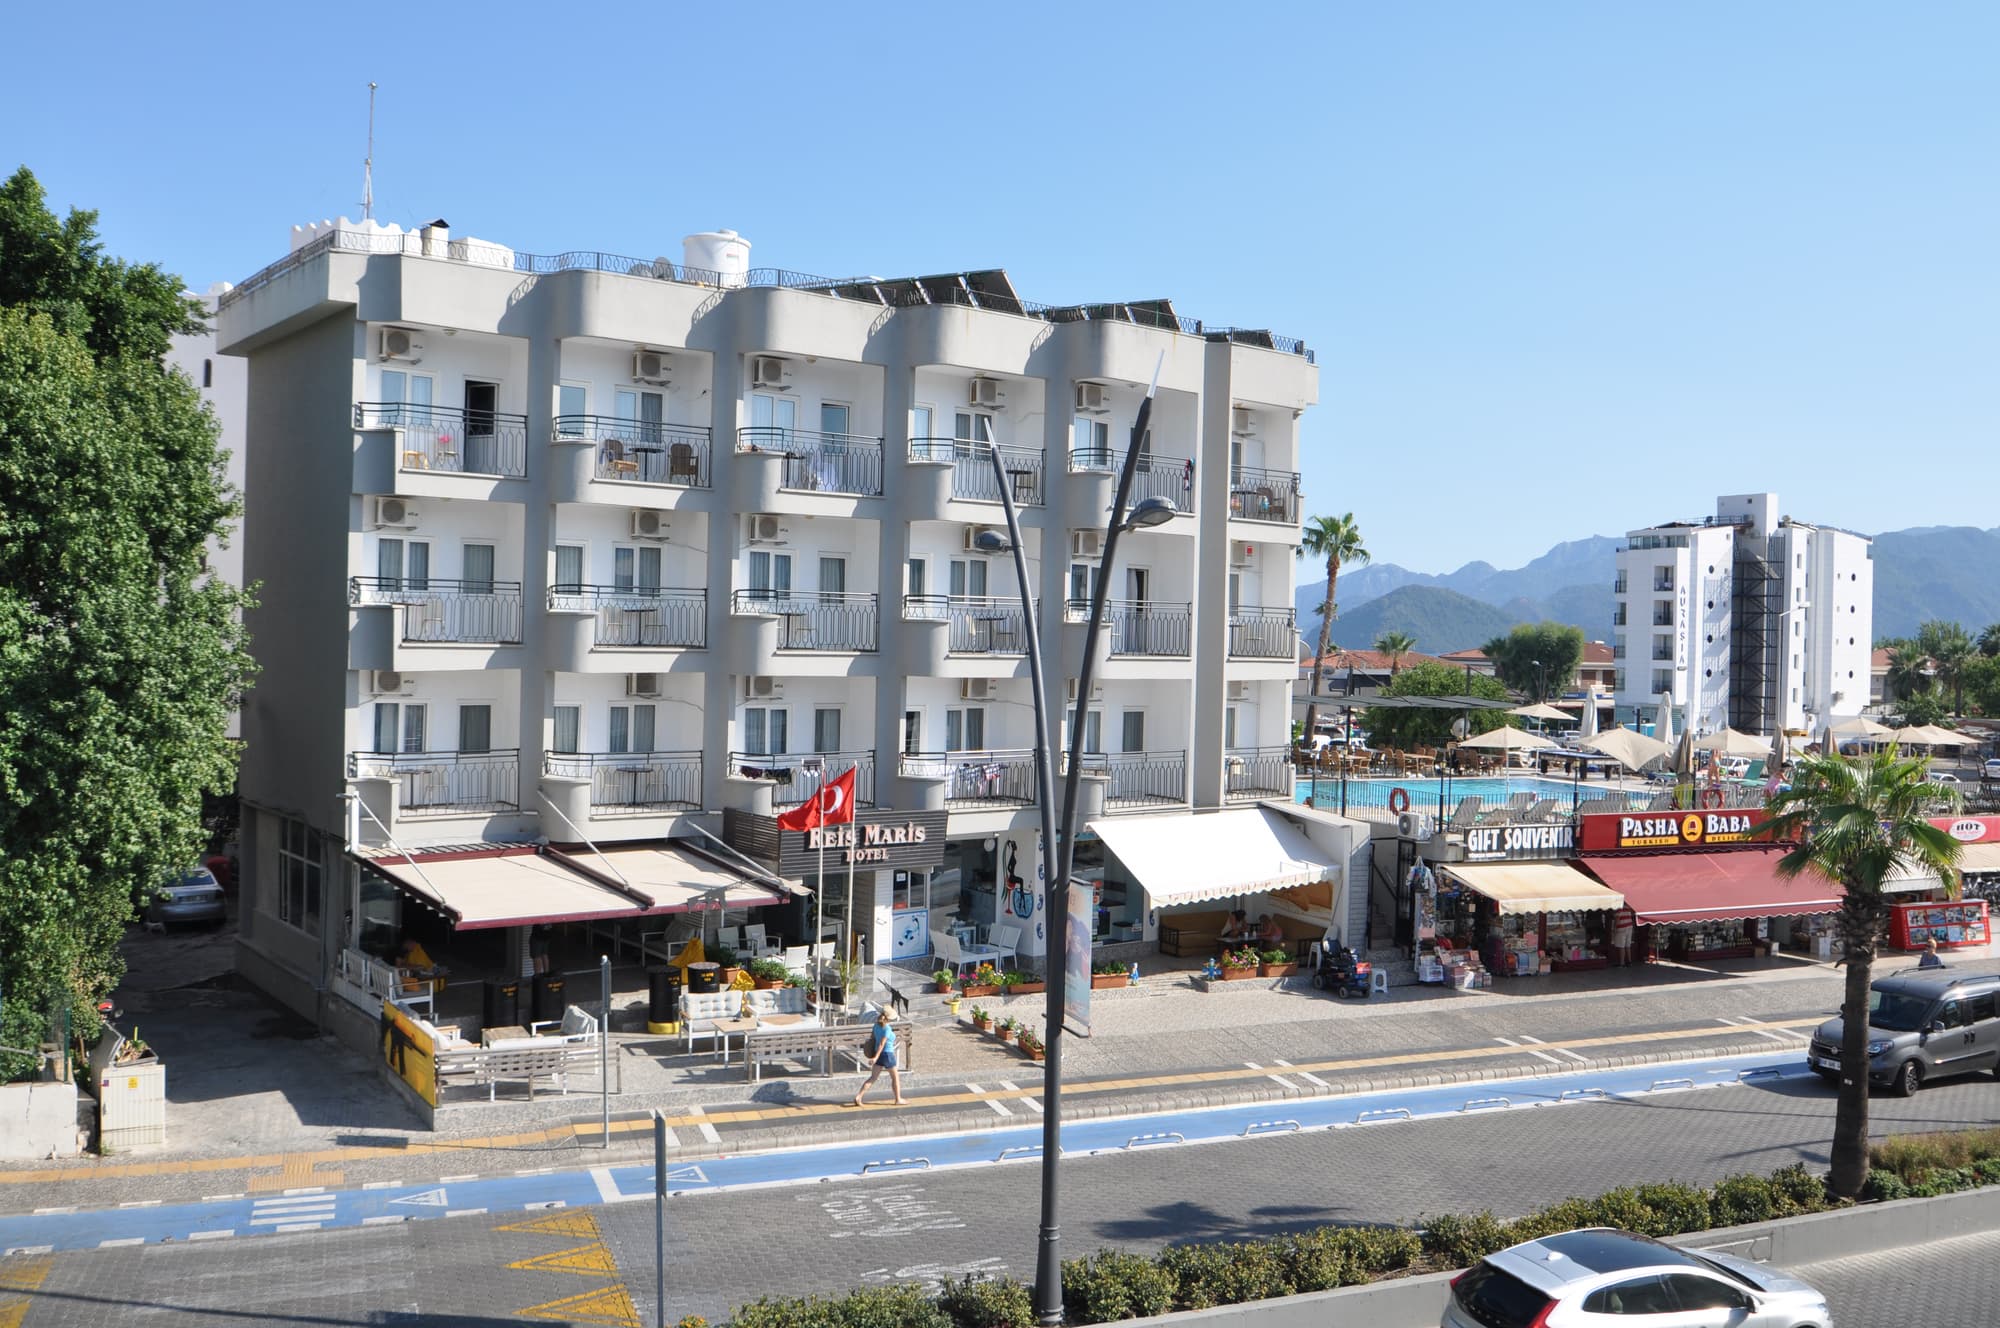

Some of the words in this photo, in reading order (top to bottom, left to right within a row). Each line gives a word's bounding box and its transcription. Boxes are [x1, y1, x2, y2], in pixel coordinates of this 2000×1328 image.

[1621, 817, 1679, 838] PASHA
[1706, 814, 1751, 834] BABA
[1467, 828, 1500, 851] GIFT
[1503, 826, 1574, 850] SOUVENIR
[846, 848, 889, 861] HOTEL
